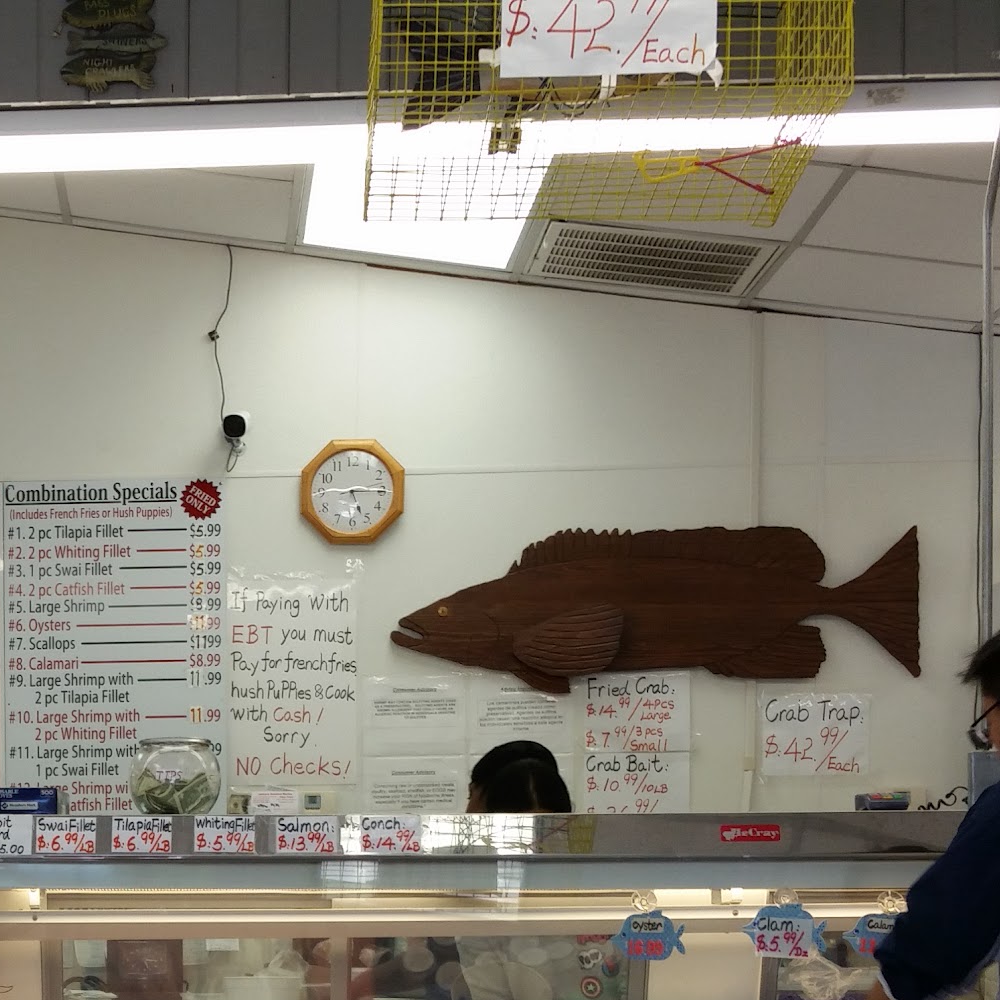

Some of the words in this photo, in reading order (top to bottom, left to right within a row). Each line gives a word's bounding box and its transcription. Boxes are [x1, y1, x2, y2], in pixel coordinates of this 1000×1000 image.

[5, 484, 108, 504] Combination
[113, 481, 178, 505] Specials
[188, 484, 218, 507] FRIED
[9, 508, 48, 521] (Includes
[50, 508, 78, 519] French
[80, 507, 100, 519] Fries
[102, 510, 111, 518] or
[112, 507, 134, 518] Hush
[136, 506, 173, 521] Puppies)
[184, 494, 211, 515] ONLY
[8, 526, 26, 540] #1.
[55, 525, 93, 542] Tilapia
[95, 524, 124, 539] Fillet
[190, 523, 221, 538] $5.99
[8, 546, 26, 560] #2.
[55, 544, 100, 562] Whiting
[102, 543, 131, 558] Fillet
[190, 543, 221, 559] $5.99
[8, 564, 26, 578] #3.
[55, 562, 82, 577] Swai
[84, 561, 113, 576] Fillet
[190, 561, 221, 575] $5.99
[8, 583, 26, 597] #4.
[55, 581, 94, 597] Catfish
[97, 581, 125, 595] Fillet
[190, 581, 221, 596] $5.99
[8, 601, 26, 614] #5.
[29, 600, 61, 616] Large
[64, 599, 105, 615] Shrimp
[230, 587, 248, 613] If
[256, 591, 300, 618] Paying
[8, 619, 26, 632] #6.
[29, 619, 71, 635] Oysters
[232, 624, 273, 645] EBT
[280, 628, 306, 646] you
[313, 626, 353, 645] must
[9, 638, 26, 651] #7.
[29, 637, 76, 652] Scallops
[9, 658, 27, 671] #8.
[29, 656, 79, 671] Calamari
[190, 653, 221, 668] $8.99
[230, 651, 259, 677] Pay
[261, 650, 282, 672] for
[284, 650, 328, 673] french
[9, 675, 27, 687] #9.
[29, 674, 61, 690] Large
[64, 673, 105, 689] Shrimp
[107, 672, 134, 686] with
[587, 677, 631, 699] Fried
[635, 676, 675, 695] Crab:
[61, 690, 99, 706] Tilapia
[102, 690, 130, 703] Fillet
[231, 681, 265, 699] hush
[325, 685, 356, 701] Cook
[9, 710, 34, 724] #10.
[36, 710, 68, 726] Large
[71, 709, 113, 726] Shrimp
[114, 708, 140, 723] with
[230, 703, 268, 723] with
[766, 698, 810, 723] Crab
[61, 727, 106, 744] Whiting
[109, 726, 137, 740] Fillet
[9, 746, 34, 760] #11.
[37, 746, 69, 762] Large
[71, 745, 113, 761] Shrimp
[630, 739, 668, 752] Small
[61, 763, 89, 777] Swai
[91, 763, 119, 776] Fillet
[236, 757, 262, 776] NO
[270, 753, 351, 779] Checks!
[586, 755, 621, 772] Crab
[71, 782, 113, 797] Shrimp
[104, 797, 133, 811] Fillet
[38, 818, 69, 832] Swai
[68, 818, 97, 833] Fillet
[114, 818, 152, 835] Tilapia
